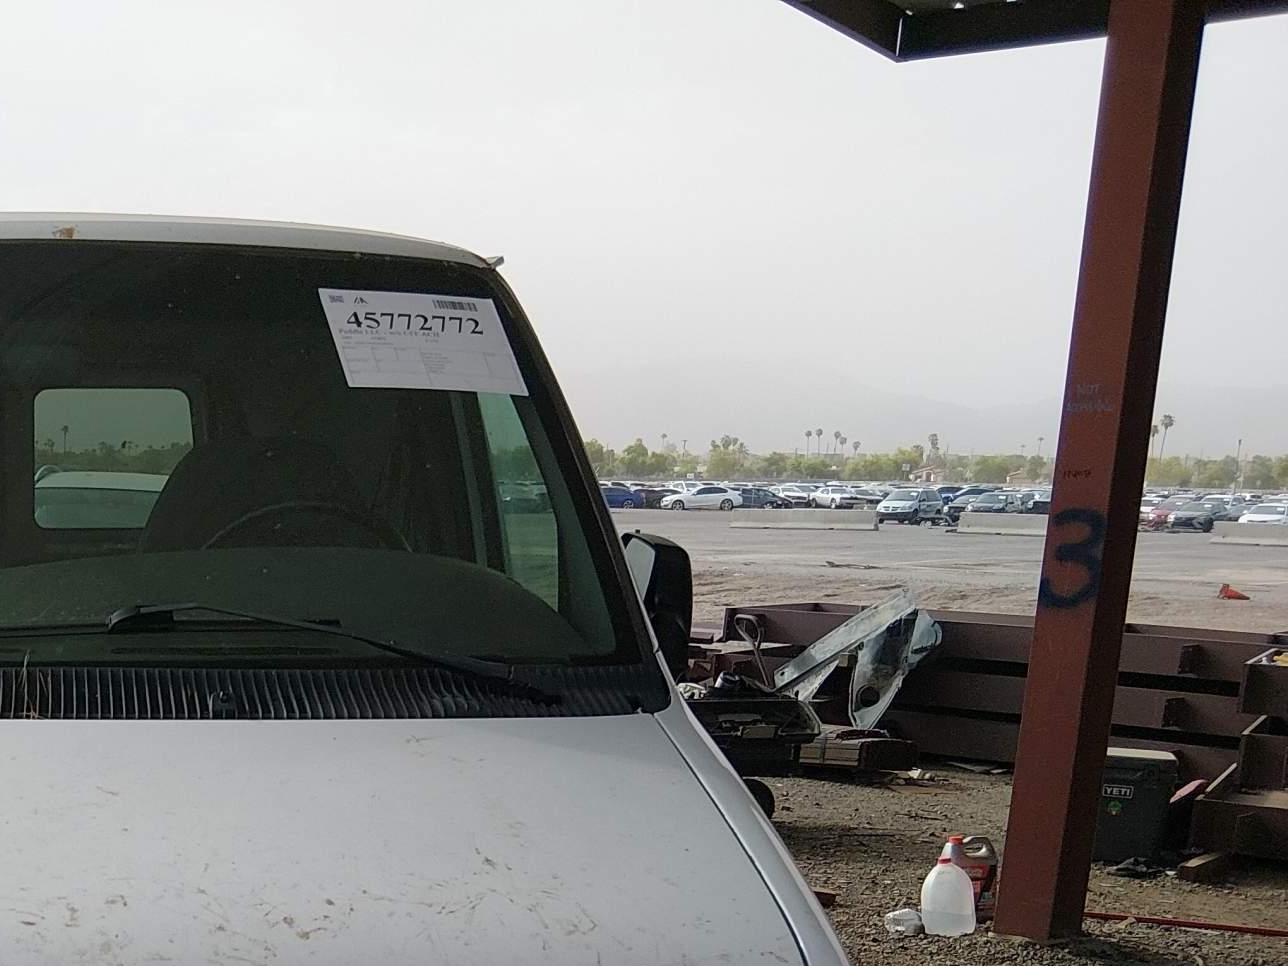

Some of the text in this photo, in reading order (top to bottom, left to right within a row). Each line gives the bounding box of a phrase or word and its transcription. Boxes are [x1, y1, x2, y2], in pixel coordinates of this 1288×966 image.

[346, 311, 484, 335] 45772772
[1040, 507, 1107, 608] 3
[1105, 786, 1131, 796] YETI
